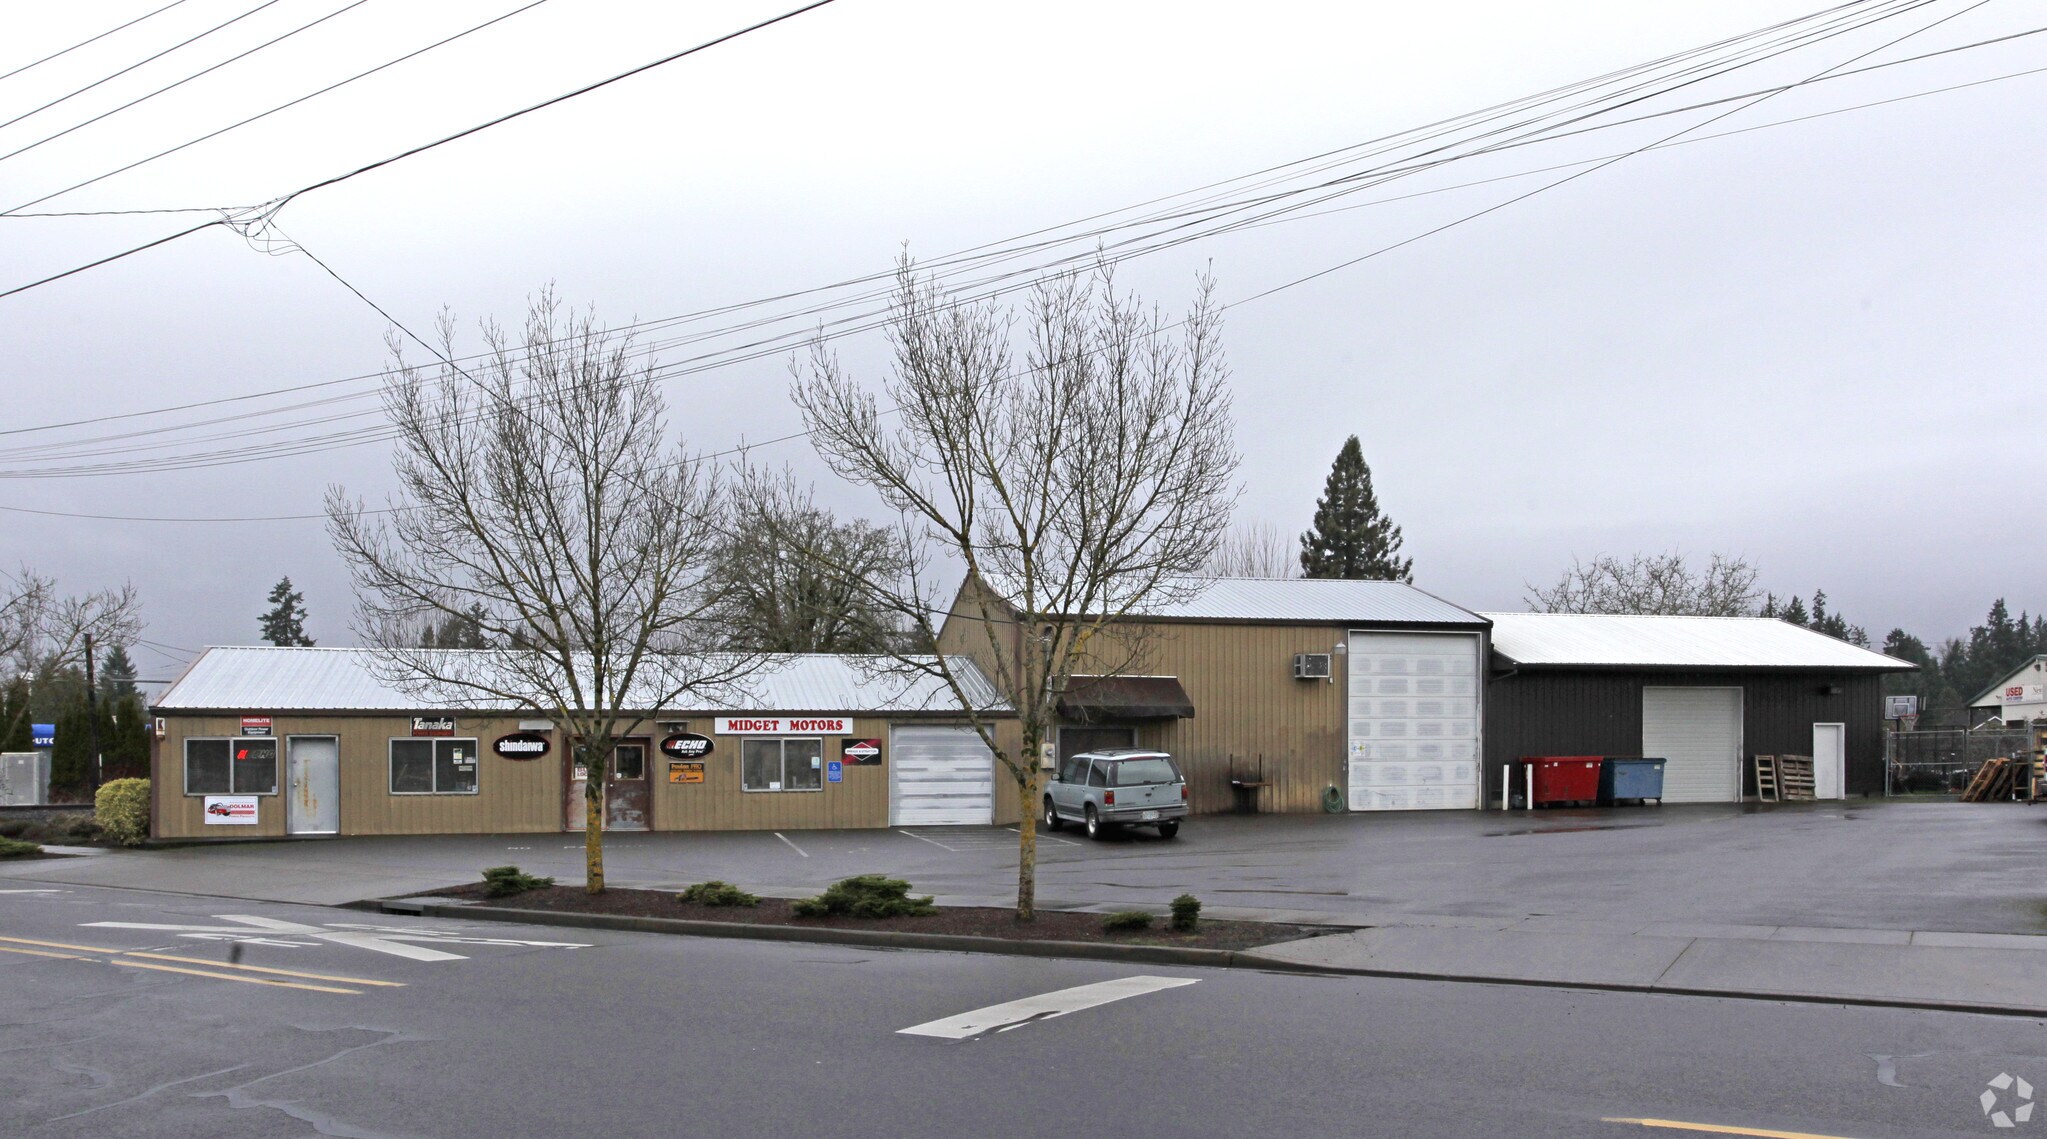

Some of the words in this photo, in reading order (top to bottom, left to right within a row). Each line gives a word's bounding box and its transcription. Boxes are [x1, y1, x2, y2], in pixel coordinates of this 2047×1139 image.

[2006, 687, 2023, 696] USED
[413, 718, 453, 730] Tanaka
[728, 720, 779, 731] MIDGET
[789, 720, 843, 731] MOTORS
[499, 739, 543, 752] shindaiwa
[675, 740, 707, 750] ECHO
